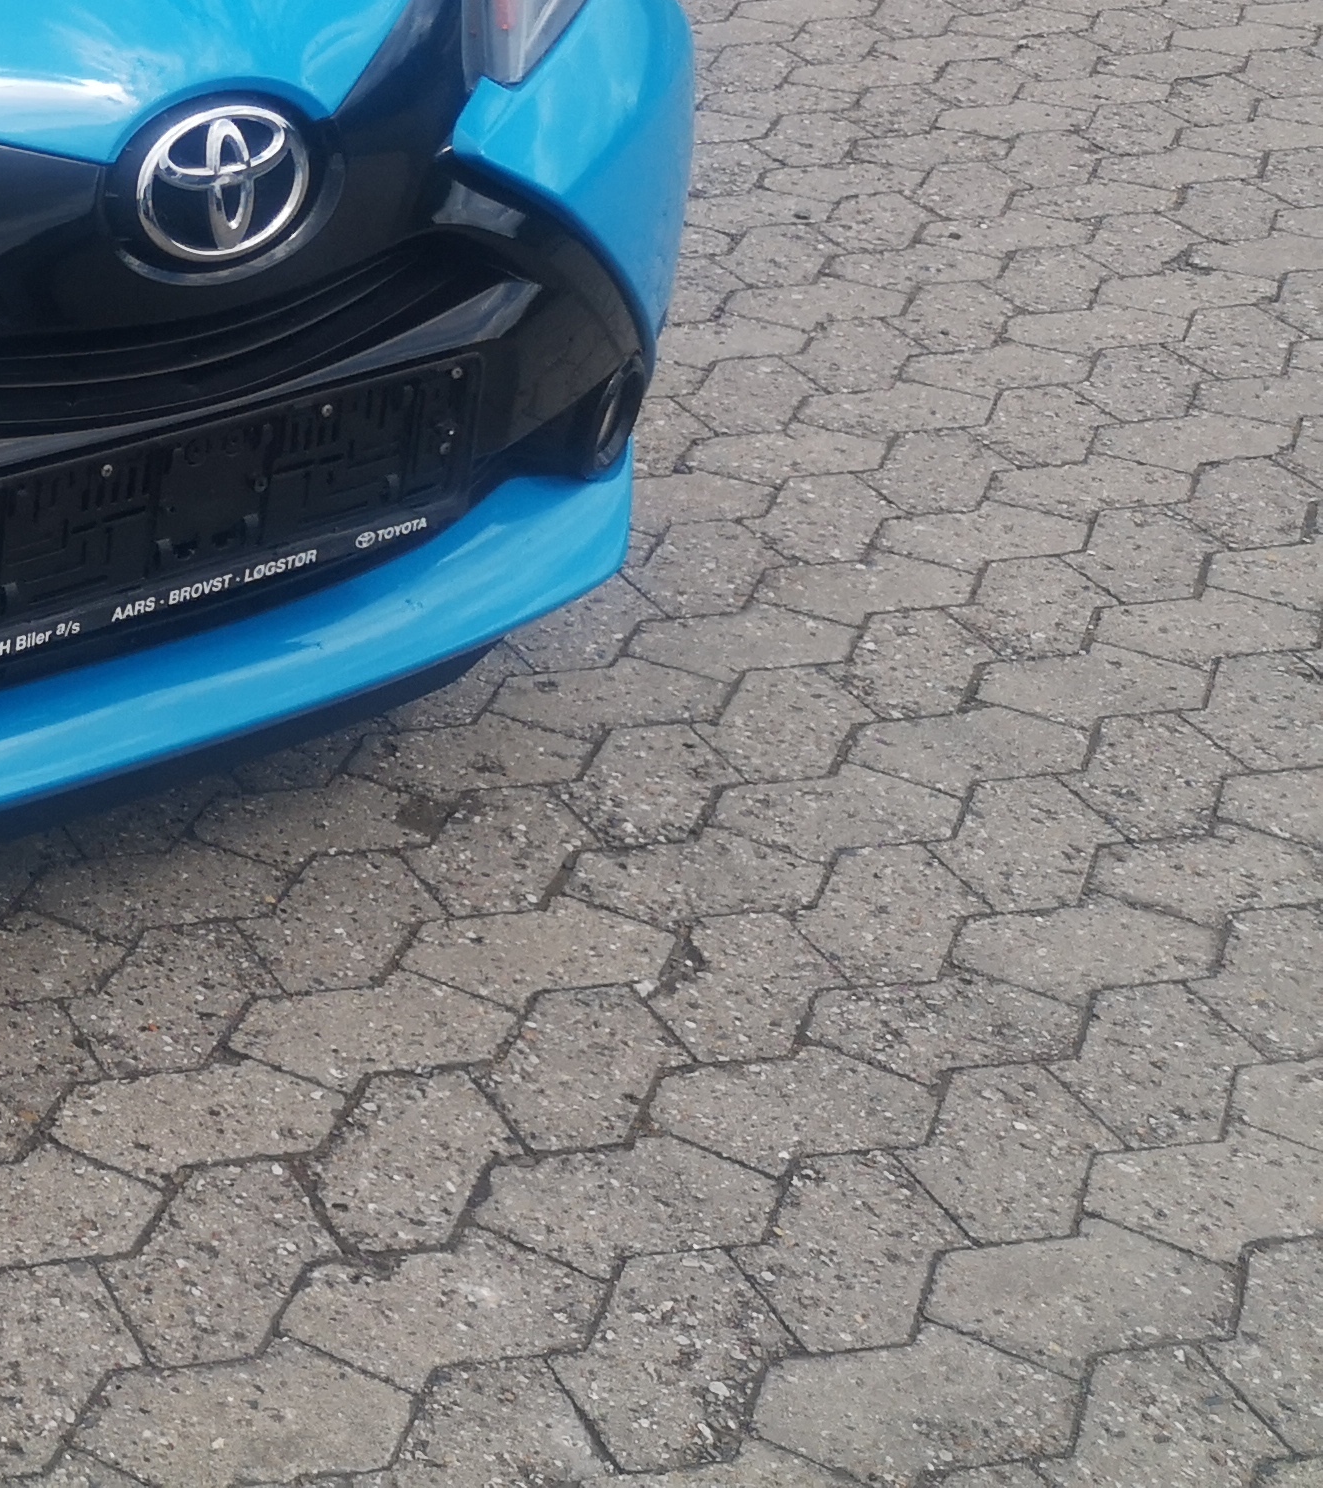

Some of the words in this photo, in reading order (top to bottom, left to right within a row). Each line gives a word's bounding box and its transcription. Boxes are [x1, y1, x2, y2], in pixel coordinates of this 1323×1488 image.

[376, 517, 427, 542] TOYOTA
[15, 629, 53, 652] Biler
[56, 620, 81, 637] a/s
[111, 596, 156, 622] AARS
[168, 574, 233, 605] BROVST
[244, 549, 318, 583] LØGSTØR
